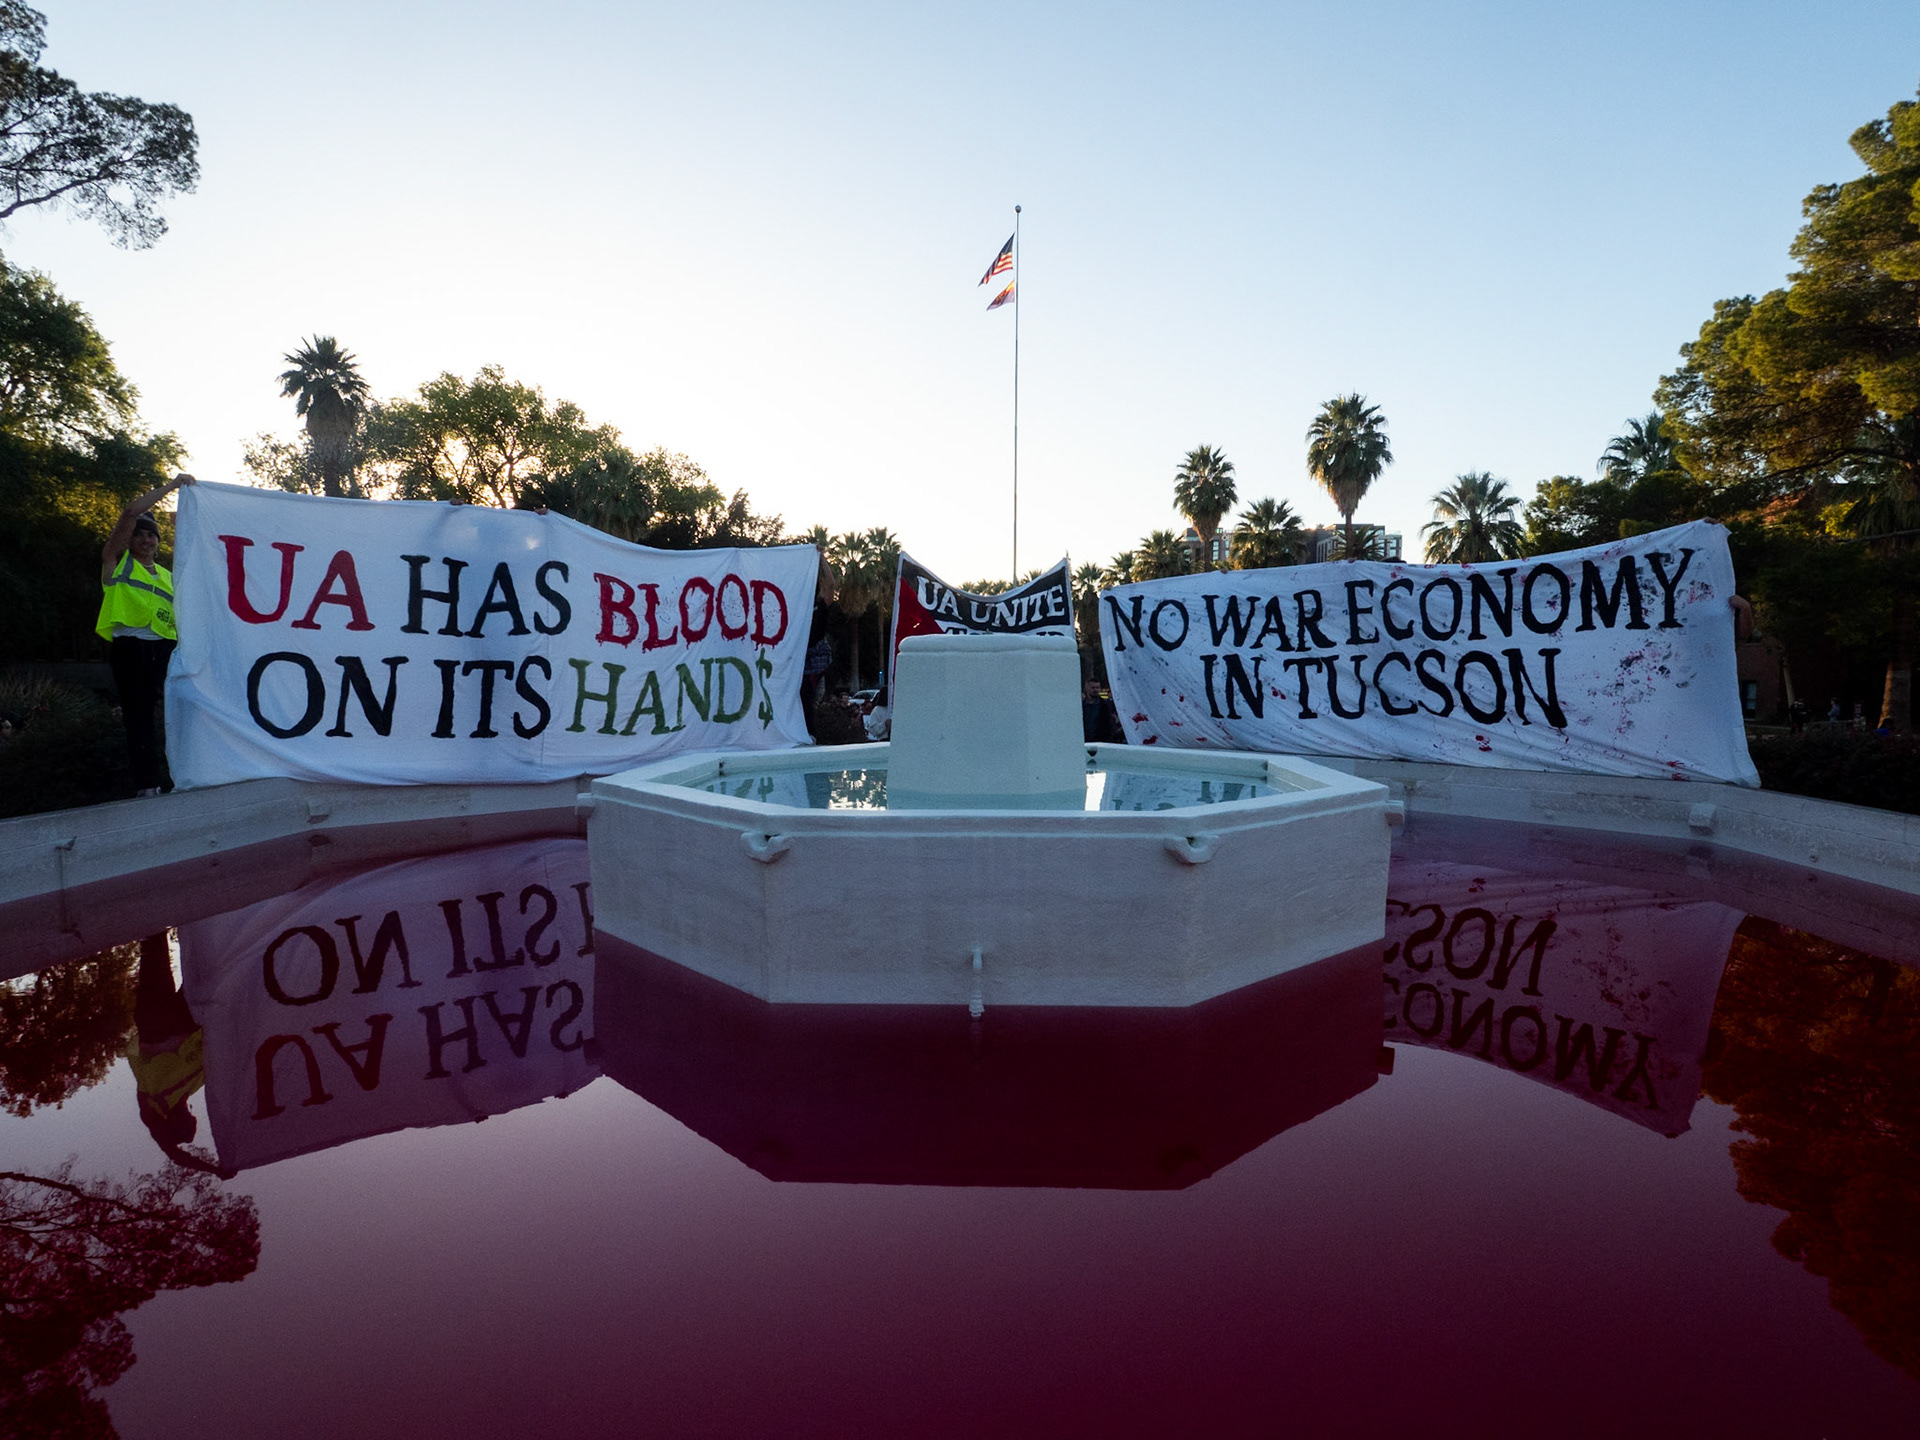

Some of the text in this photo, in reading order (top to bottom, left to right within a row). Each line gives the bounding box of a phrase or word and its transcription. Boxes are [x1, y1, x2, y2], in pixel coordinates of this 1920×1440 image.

[217, 534, 789, 652] UA HAS BLOOD
[916, 575, 1065, 627] UA UNITE
[1103, 547, 1693, 653] NO WAR ECONOMY
[247, 651, 409, 739] ON
[430, 654, 552, 739] ITS
[1200, 647, 1568, 729] IN TUCSON
